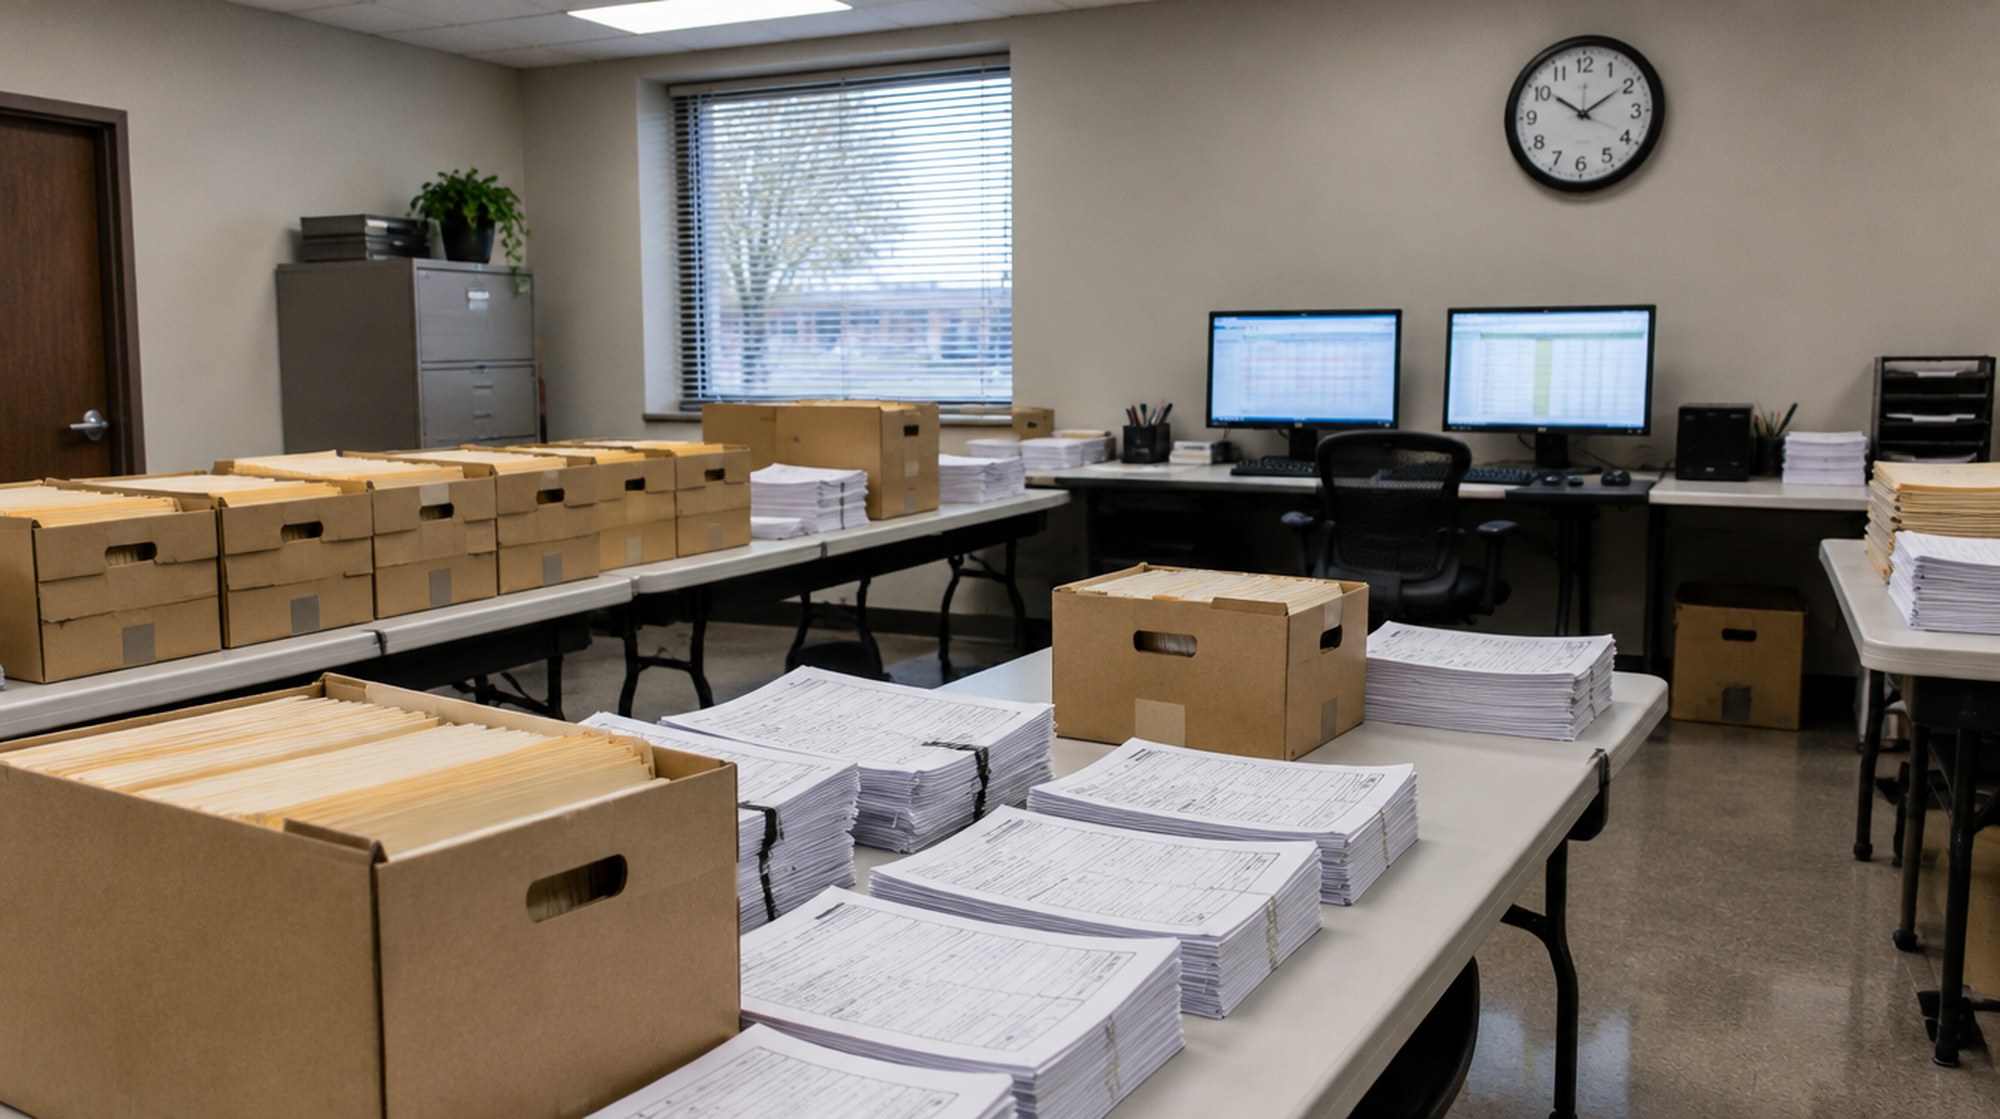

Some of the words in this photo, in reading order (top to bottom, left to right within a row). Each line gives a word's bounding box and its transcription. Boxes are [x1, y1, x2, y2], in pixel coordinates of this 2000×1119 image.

[1576, 56, 1594, 74] 12
[1607, 62, 1614, 78] 1
[1553, 65, 1566, 82] 11
[1534, 85, 1552, 101] 10
[1622, 78, 1635, 95] 2
[1526, 110, 1537, 126] 9
[1630, 103, 1642, 120] 3
[1533, 134, 1545, 150] 8
[1619, 129, 1631, 145] 4
[1552, 150, 1563, 166] 7
[1601, 147, 1613, 164] 5
[1575, 156, 1587, 172] 6
